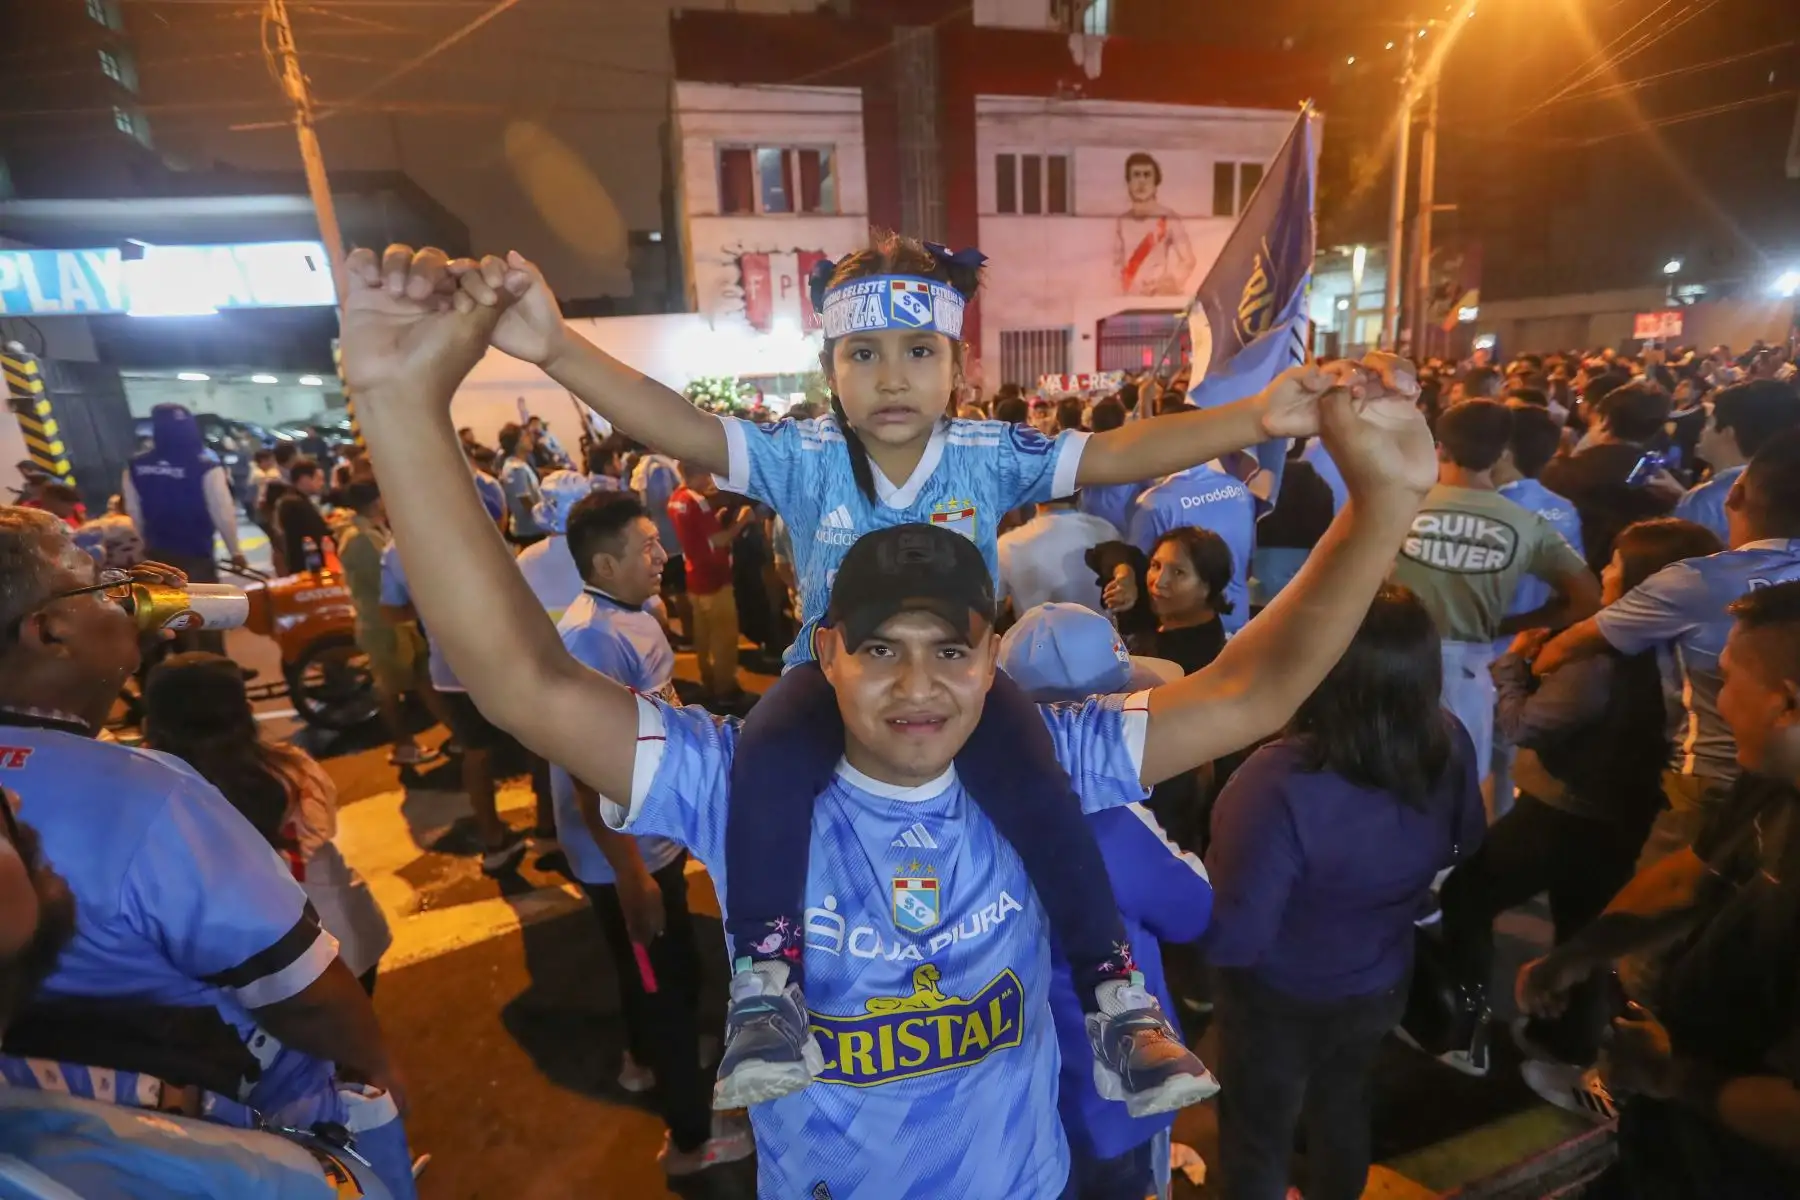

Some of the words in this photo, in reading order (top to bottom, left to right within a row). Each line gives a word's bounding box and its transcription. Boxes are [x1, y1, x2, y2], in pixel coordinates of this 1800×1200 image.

[1404, 536, 1505, 570] SILVER
[1411, 514, 1508, 544] QUIK
[930, 890, 1024, 954] PIURA
[809, 996, 1012, 1075] CRISTAL
